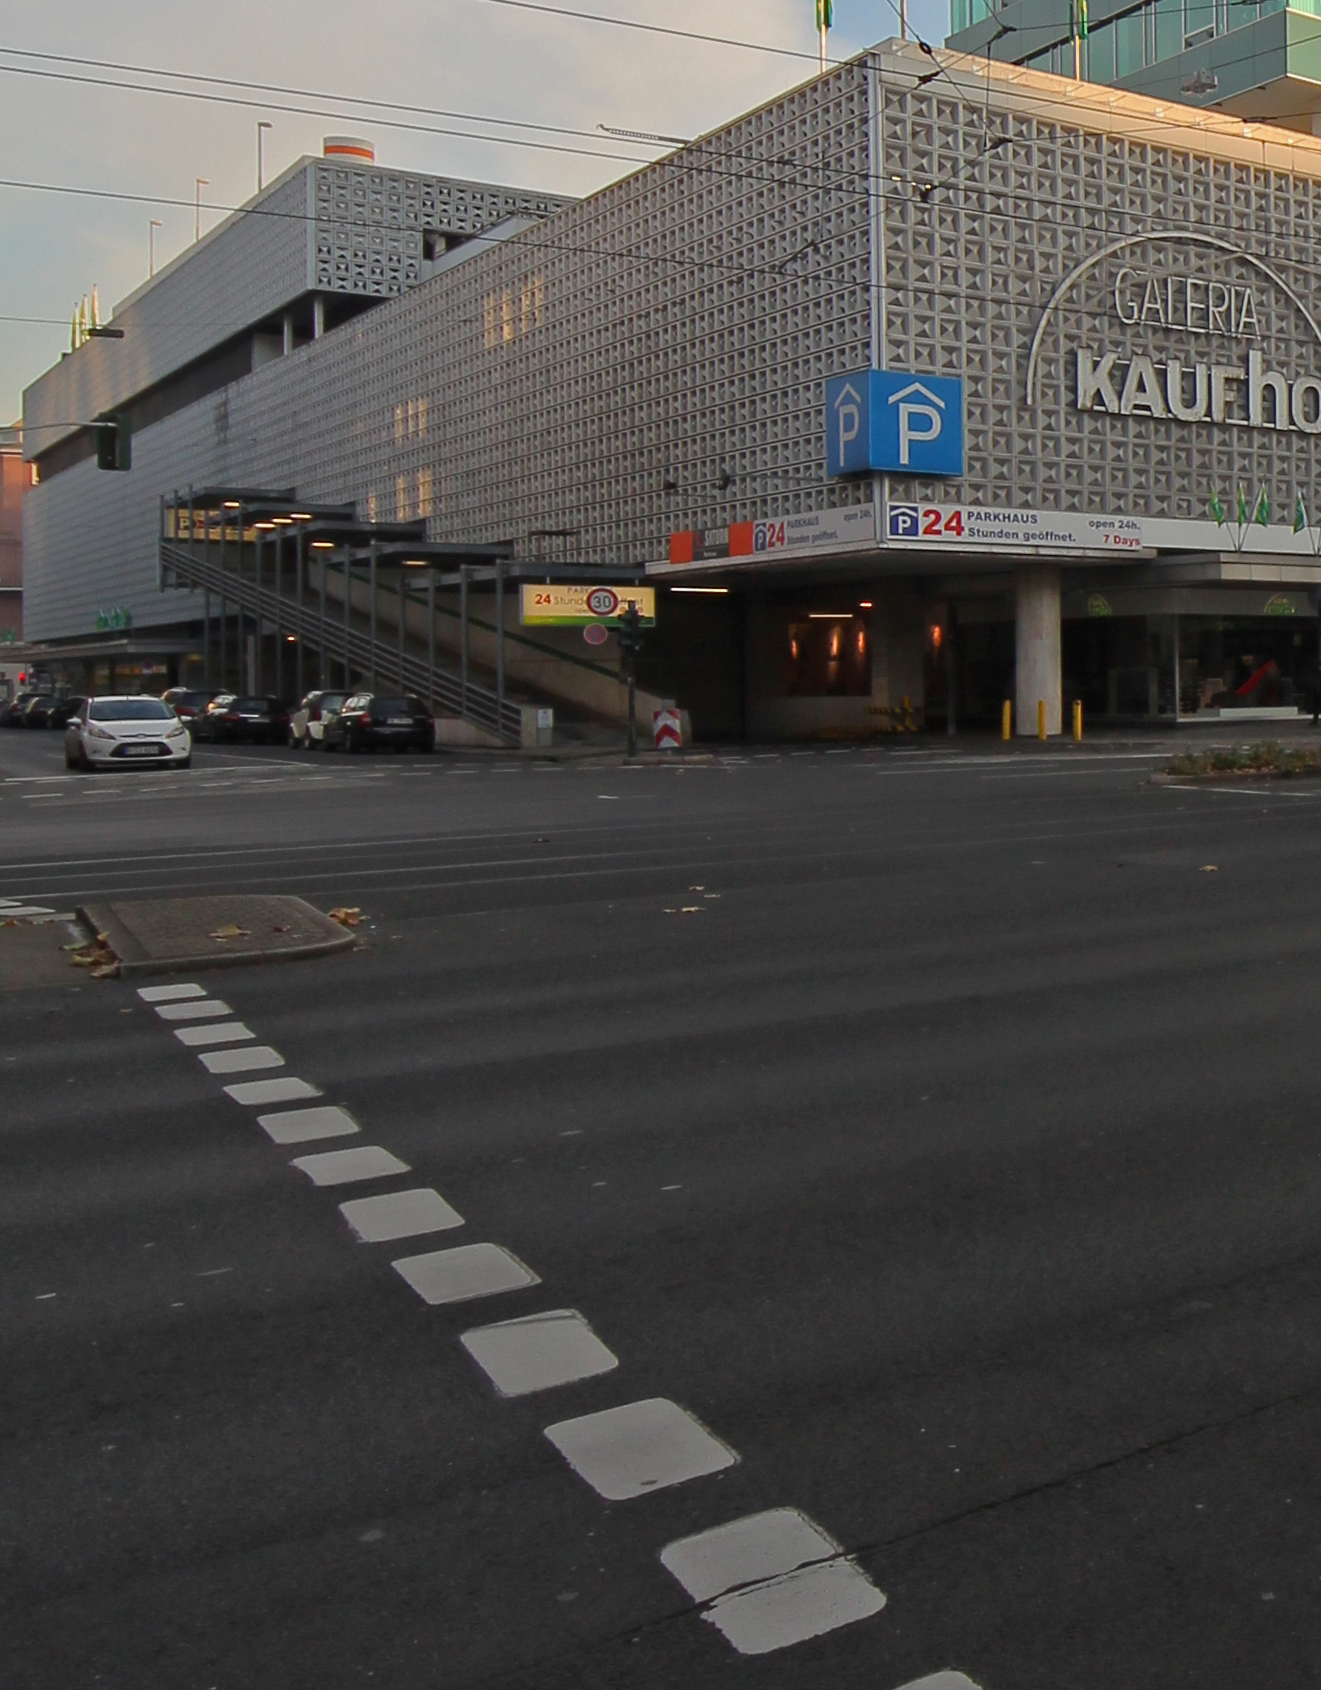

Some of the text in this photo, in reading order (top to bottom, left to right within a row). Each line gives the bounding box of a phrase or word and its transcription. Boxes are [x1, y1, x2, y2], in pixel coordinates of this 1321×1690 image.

[1115, 267, 1262, 341] GALERIA
[838, 403, 860, 467] P
[899, 402, 942, 465] P
[897, 509, 964, 537] P 24
[967, 511, 1038, 525] PARKHAUS
[1088, 519, 1141, 530] open 24h.
[767, 521, 785, 548] 24
[968, 527, 1019, 540] Stunden
[1103, 534, 1141, 547] 7 Days
[534, 594, 551, 606] 24
[593, 595, 612, 609] 30
